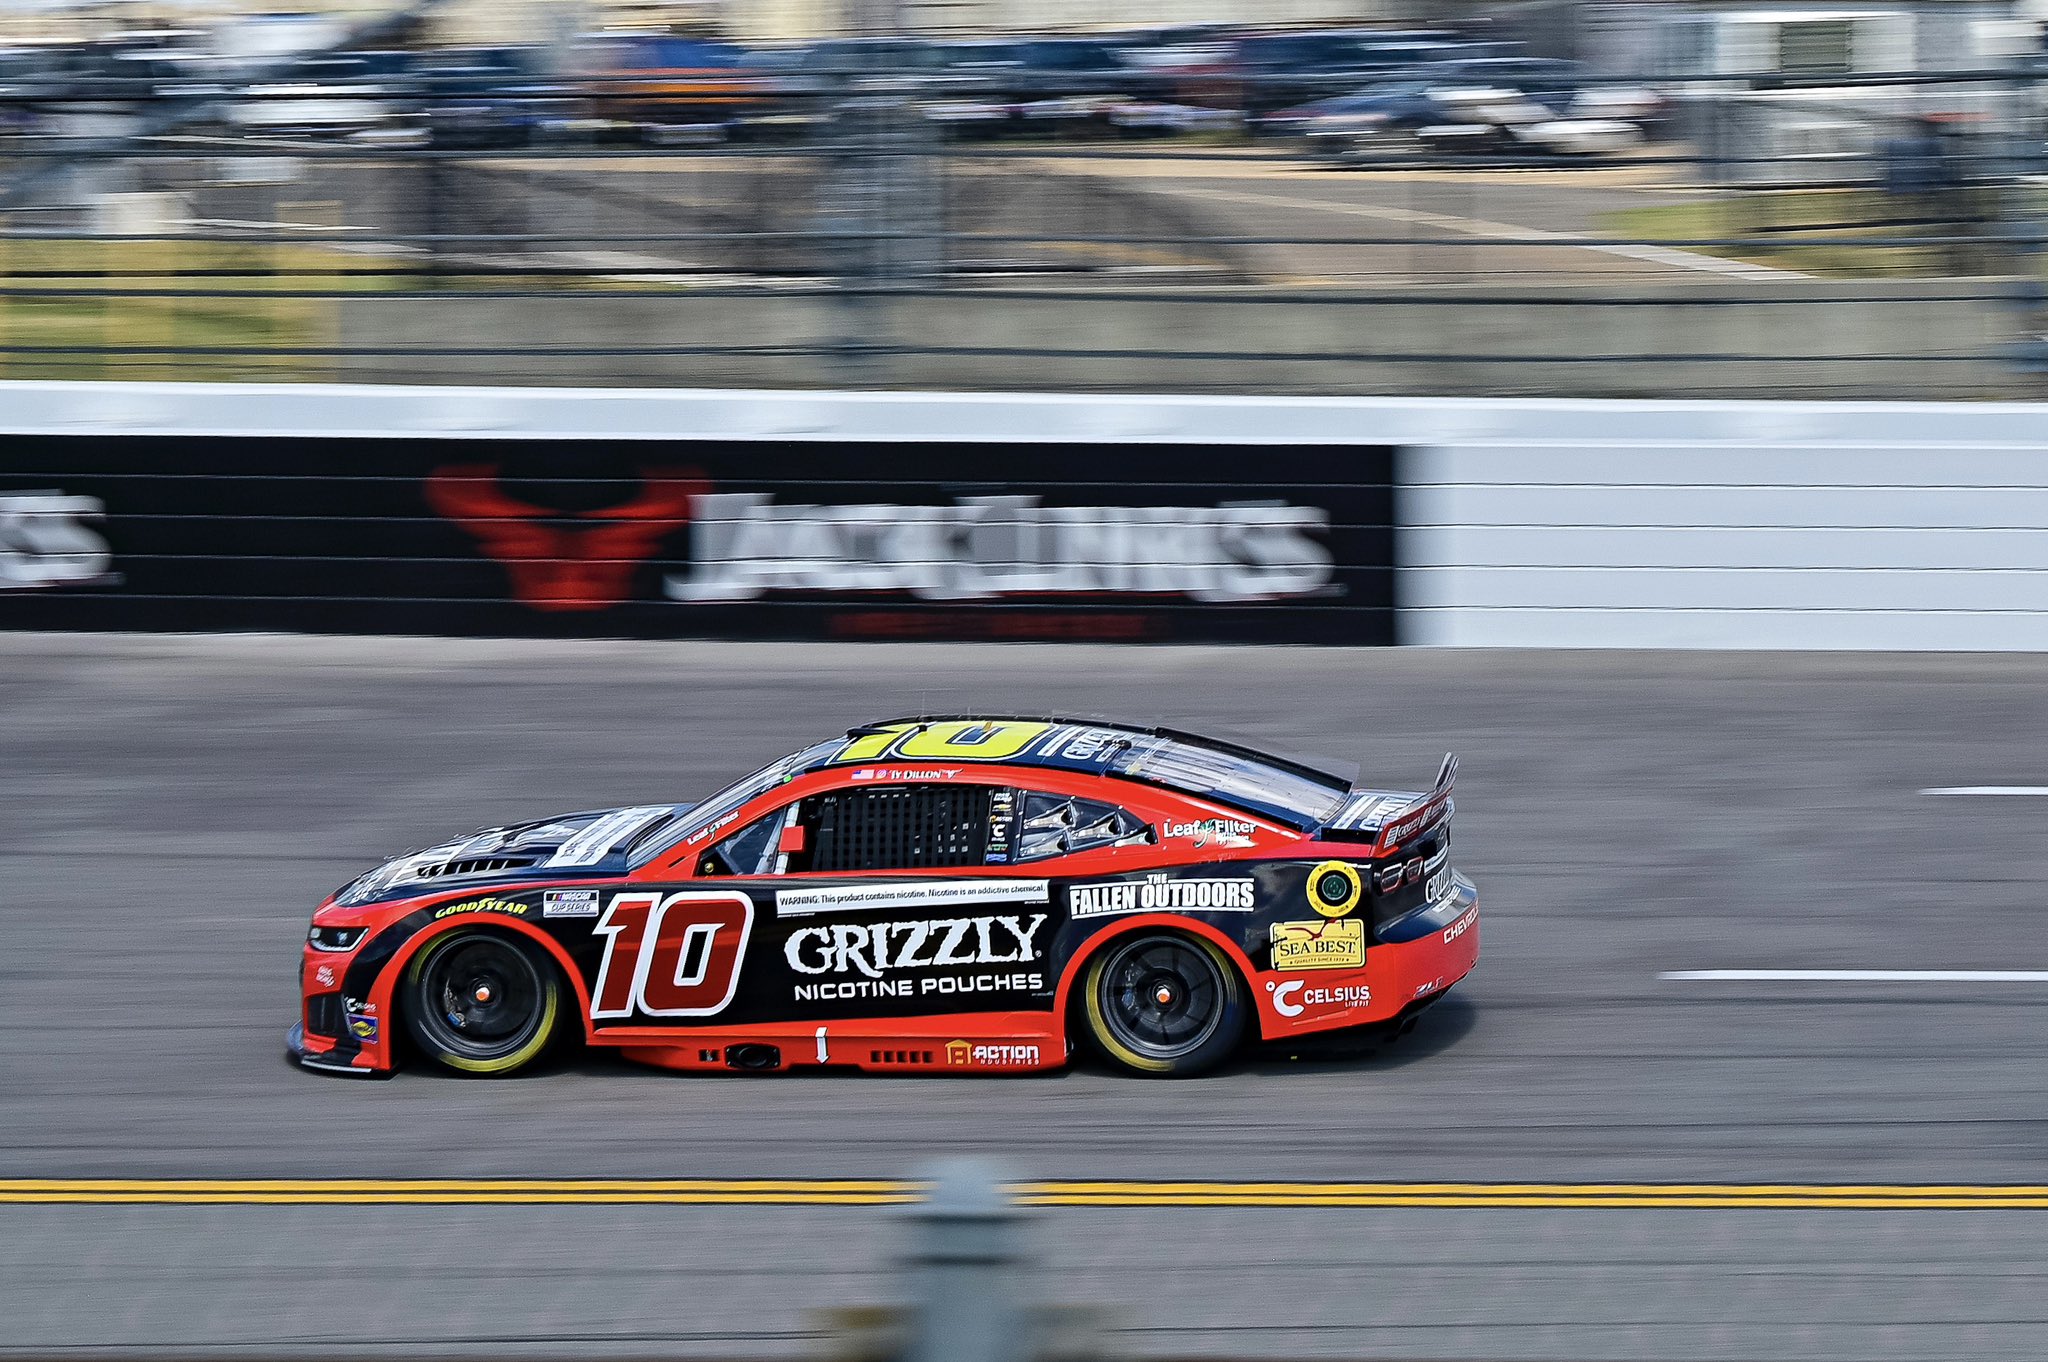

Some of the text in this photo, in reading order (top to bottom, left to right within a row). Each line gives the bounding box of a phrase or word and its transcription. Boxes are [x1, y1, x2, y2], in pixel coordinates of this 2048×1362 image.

[903, 769, 941, 780] DILLON
[1163, 820, 1202, 838] Leaf
[1147, 873, 1168, 884] THE
[821, 894, 836, 904] This
[837, 893, 865, 905] product
[865, 892, 896, 901] contains
[928, 888, 959, 897] Nicotine
[960, 888, 966, 896] is
[978, 886, 1010, 895] addictive
[1069, 882, 1255, 916] FALLEN OUTDOORS
[435, 897, 529, 919] GOODYEAR
[590, 890, 755, 1019] 10
[783, 913, 1047, 979] GRIZZLY
[1280, 942, 1311, 957] SEA
[794, 973, 1043, 1000] NICOTINE POUCHES
[1304, 985, 1370, 1004] CELSIUS
[972, 1045, 1039, 1059] ACTION
